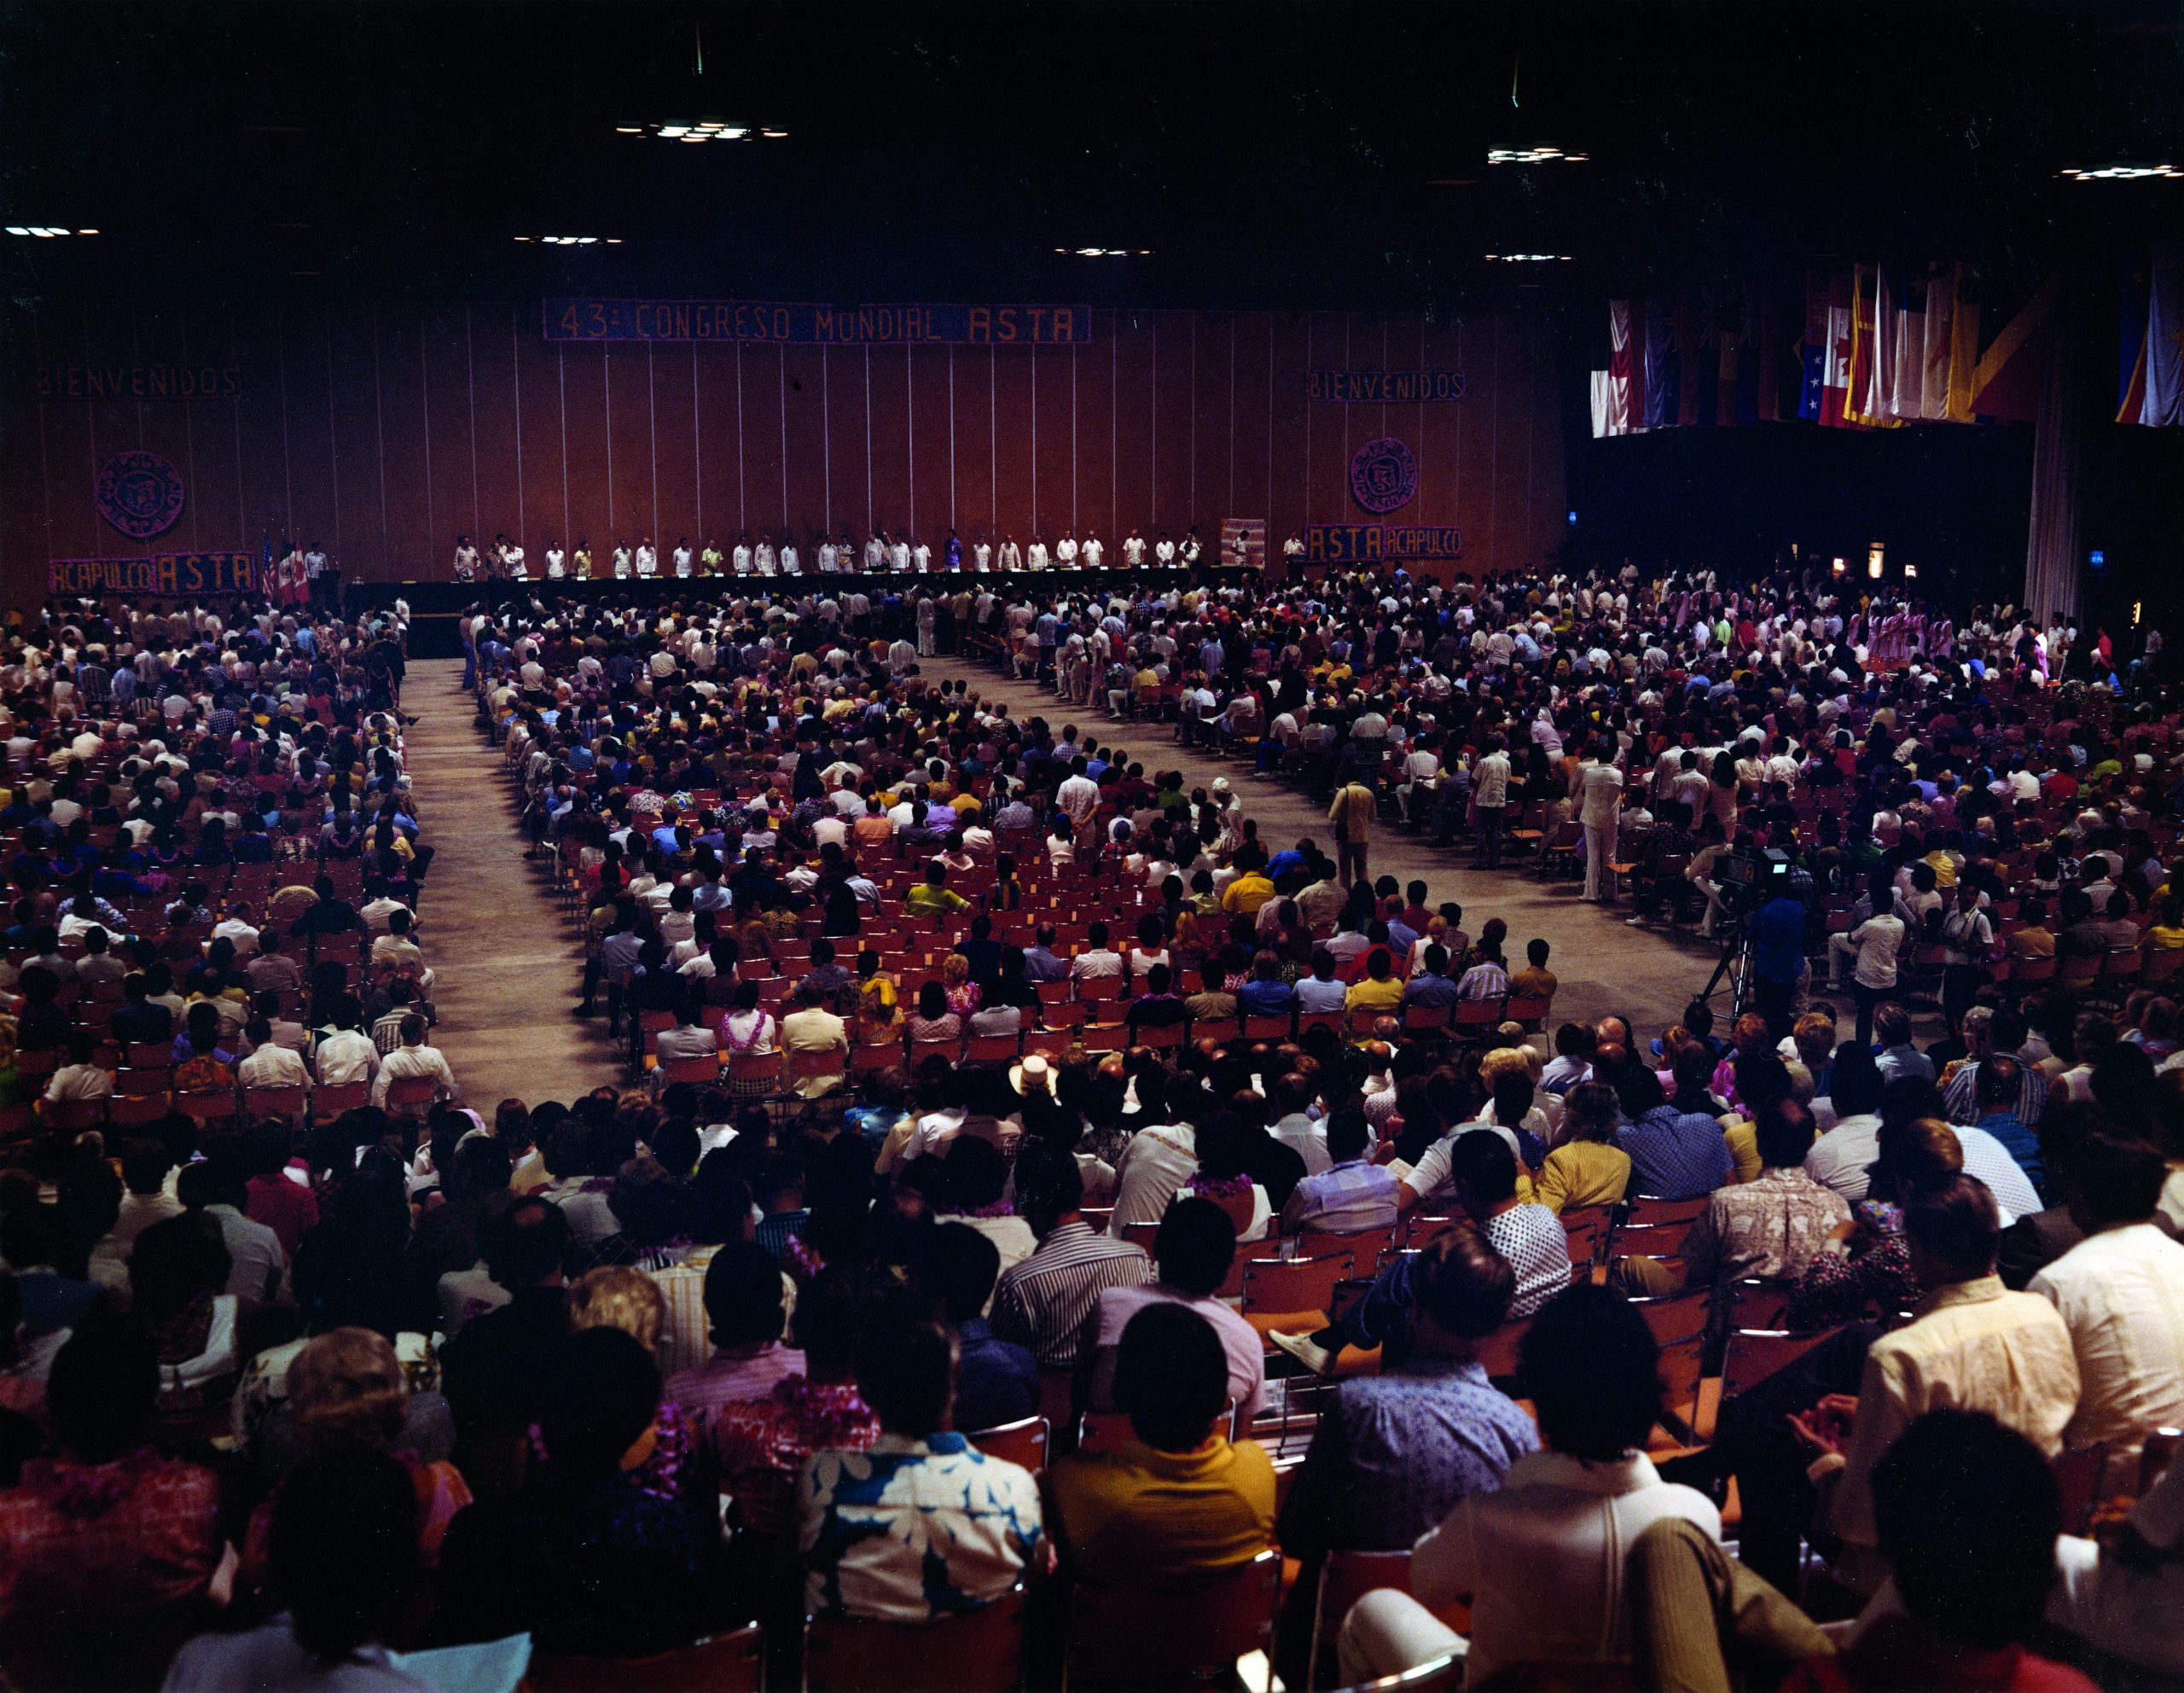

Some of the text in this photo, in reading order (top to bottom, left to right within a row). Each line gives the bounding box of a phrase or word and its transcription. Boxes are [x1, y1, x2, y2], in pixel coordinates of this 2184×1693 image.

[636, 305, 790, 340] CONGRESO
[815, 308, 942, 341] MUNDIAL
[969, 307, 1073, 341] ASTA
[36, 367, 237, 397] BIENVENIDOS
[1310, 372, 1466, 399] BIENVENIDOS
[1310, 527, 1462, 560] ASTA ACAPULCO
[53, 555, 252, 594] ACAPULCO ASTA
